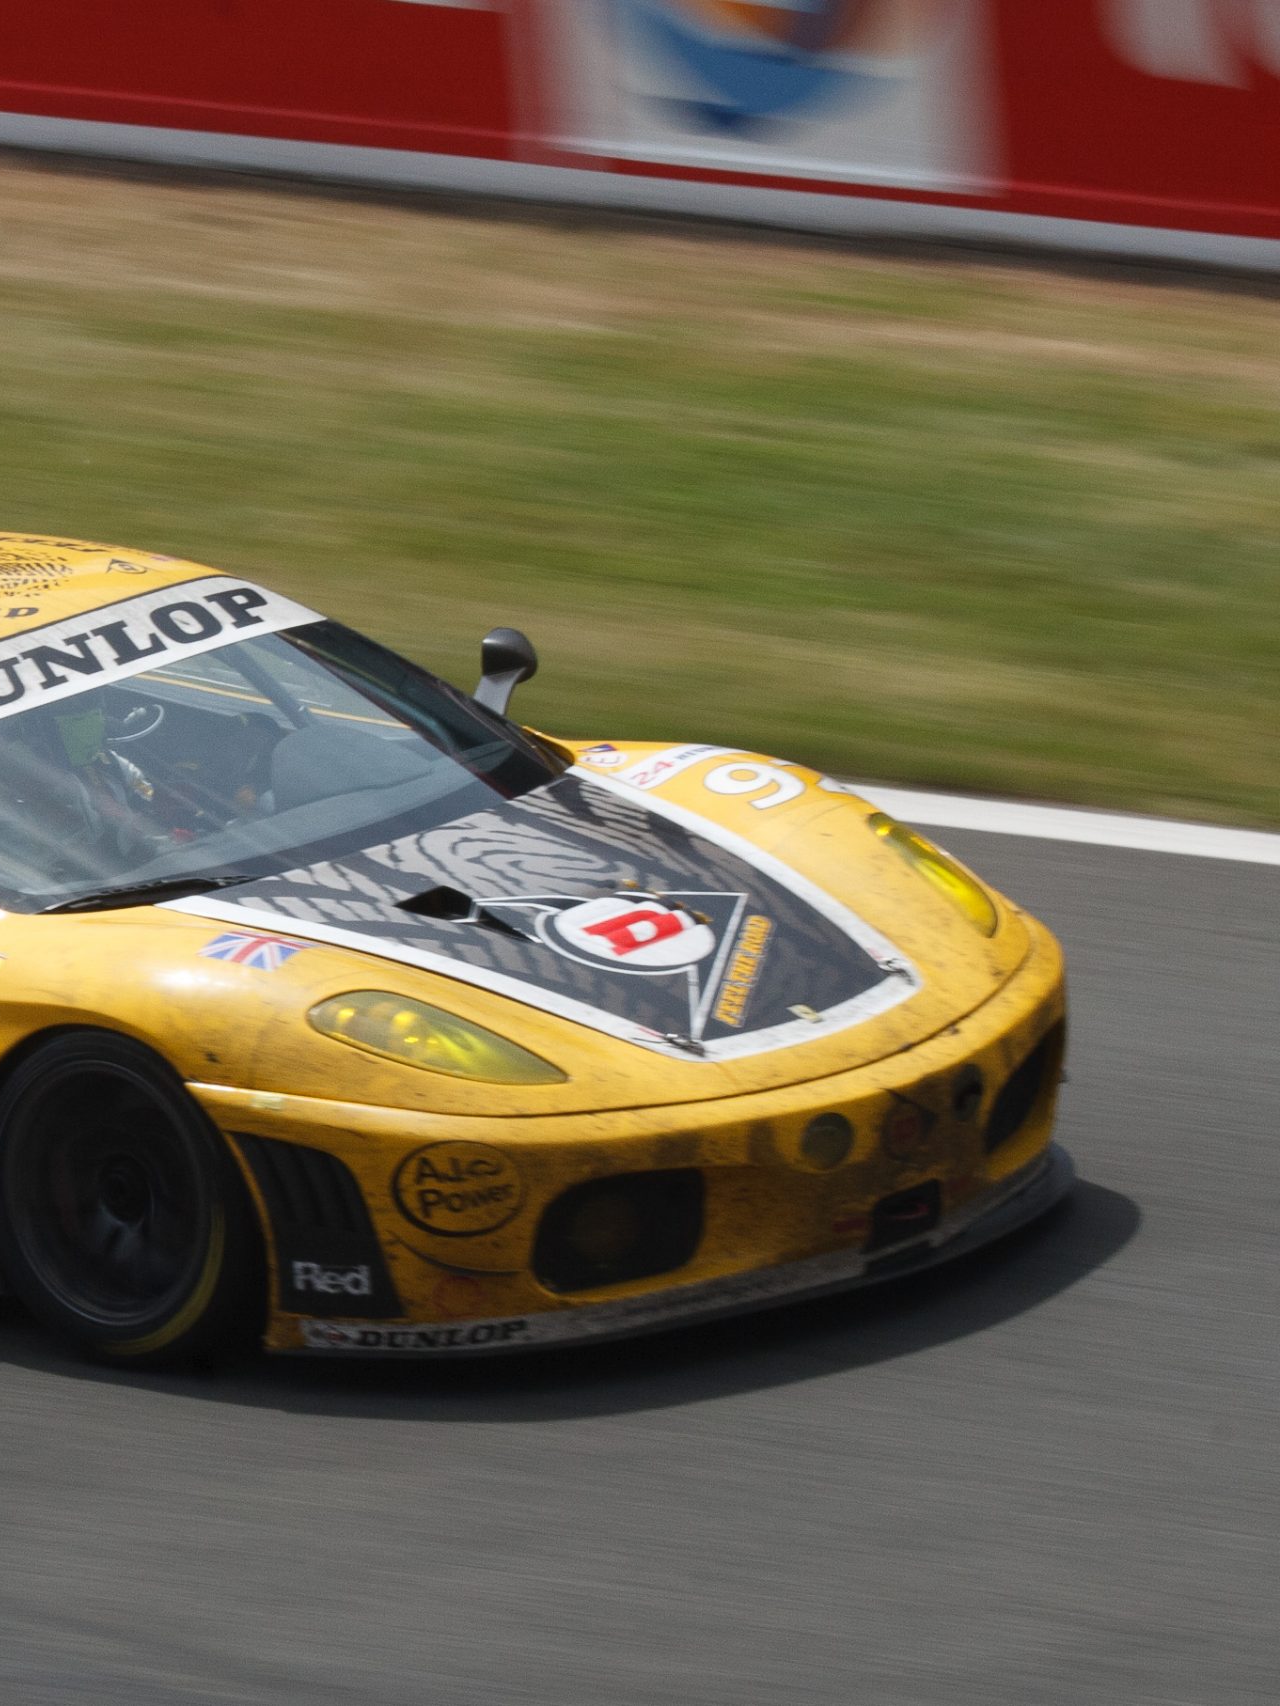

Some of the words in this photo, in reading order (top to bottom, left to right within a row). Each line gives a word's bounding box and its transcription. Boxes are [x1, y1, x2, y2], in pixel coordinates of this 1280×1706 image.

[628, 760, 675, 786] 24
[291, 1260, 371, 1296] Red
[358, 1319, 528, 1349] DUNLOP
